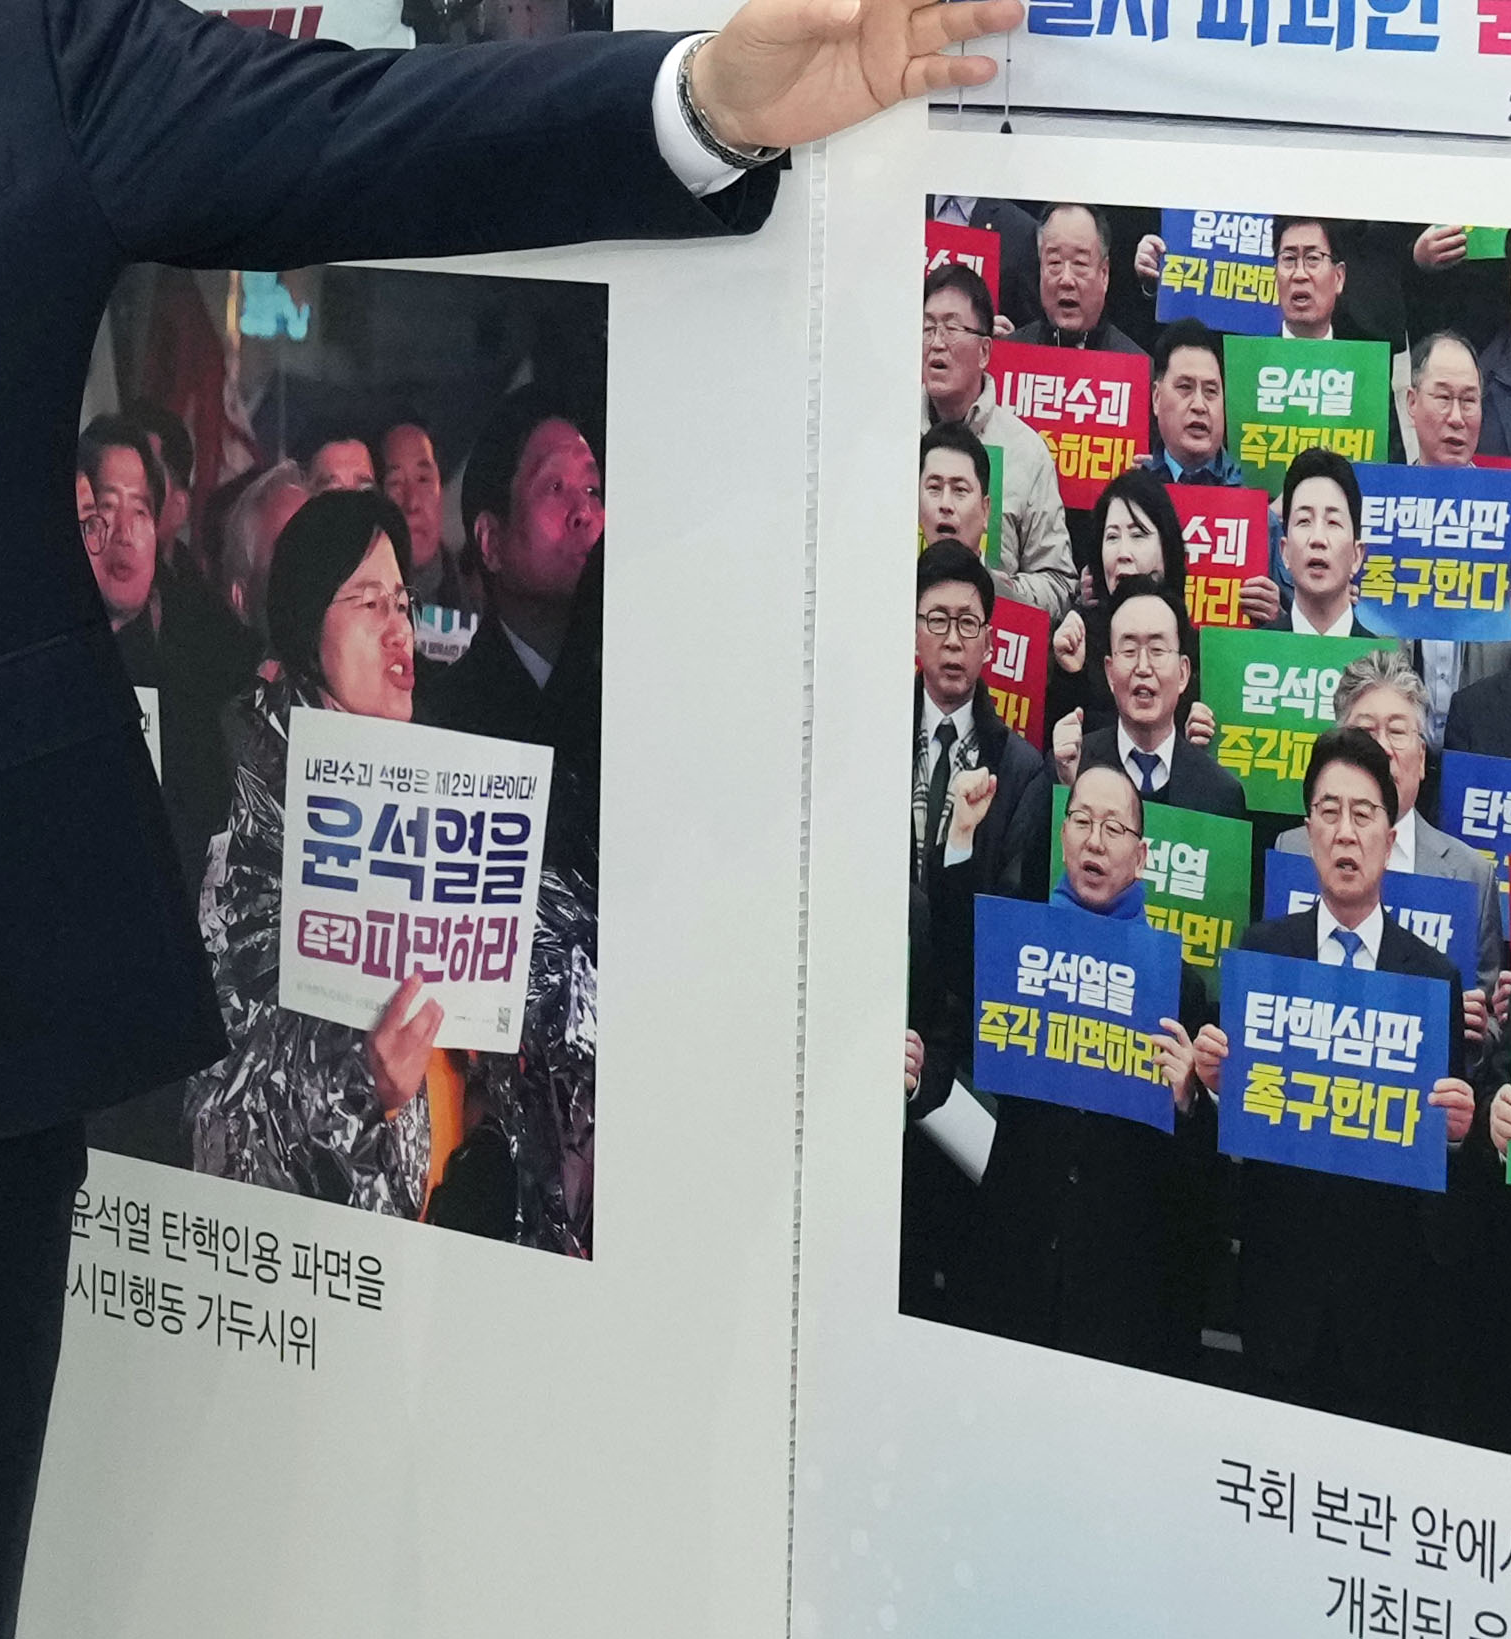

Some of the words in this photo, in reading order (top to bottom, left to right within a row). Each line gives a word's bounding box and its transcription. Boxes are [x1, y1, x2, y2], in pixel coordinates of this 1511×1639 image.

[1191, 211, 1274, 259] 윤석열
[1161, 254, 1208, 296] 즉각
[1002, 370, 1132, 428] 내란수괴
[1256, 366, 1355, 418] 윤석열
[1048, 429, 1135, 482] 하라!
[1360, 495, 1510, 551] 탄핵심판
[1359, 554, 1509, 613] 촉구한다
[305, 758, 373, 789] 내란수괴
[379, 764, 430, 794] 석방은
[435, 770, 475, 799] 제2의
[480, 774, 537, 800] 내란이다!
[302, 794, 532, 905] 윤석열을
[304, 915, 356, 960] 즉각
[361, 909, 519, 983] 파면하라
[1016, 943, 1136, 1017] 윤석열을
[978, 1000, 1041, 1057] 즉각
[1244, 991, 1424, 1074] 탄핵심판
[1242, 1062, 1421, 1148] 촉구한다
[70, 1189, 151, 1255] 윤석열
[162, 1211, 282, 1285] 탄핵인용
[291, 1242, 385, 1311] 파면을
[65, 1262, 187, 1336] 시민행동
[196, 1294, 316, 1371] 가두시위
[1216, 1458, 1296, 1534] 국회
[1311, 1480, 1398, 1557] 본관
[1326, 1575, 1452, 1639] 개최된
